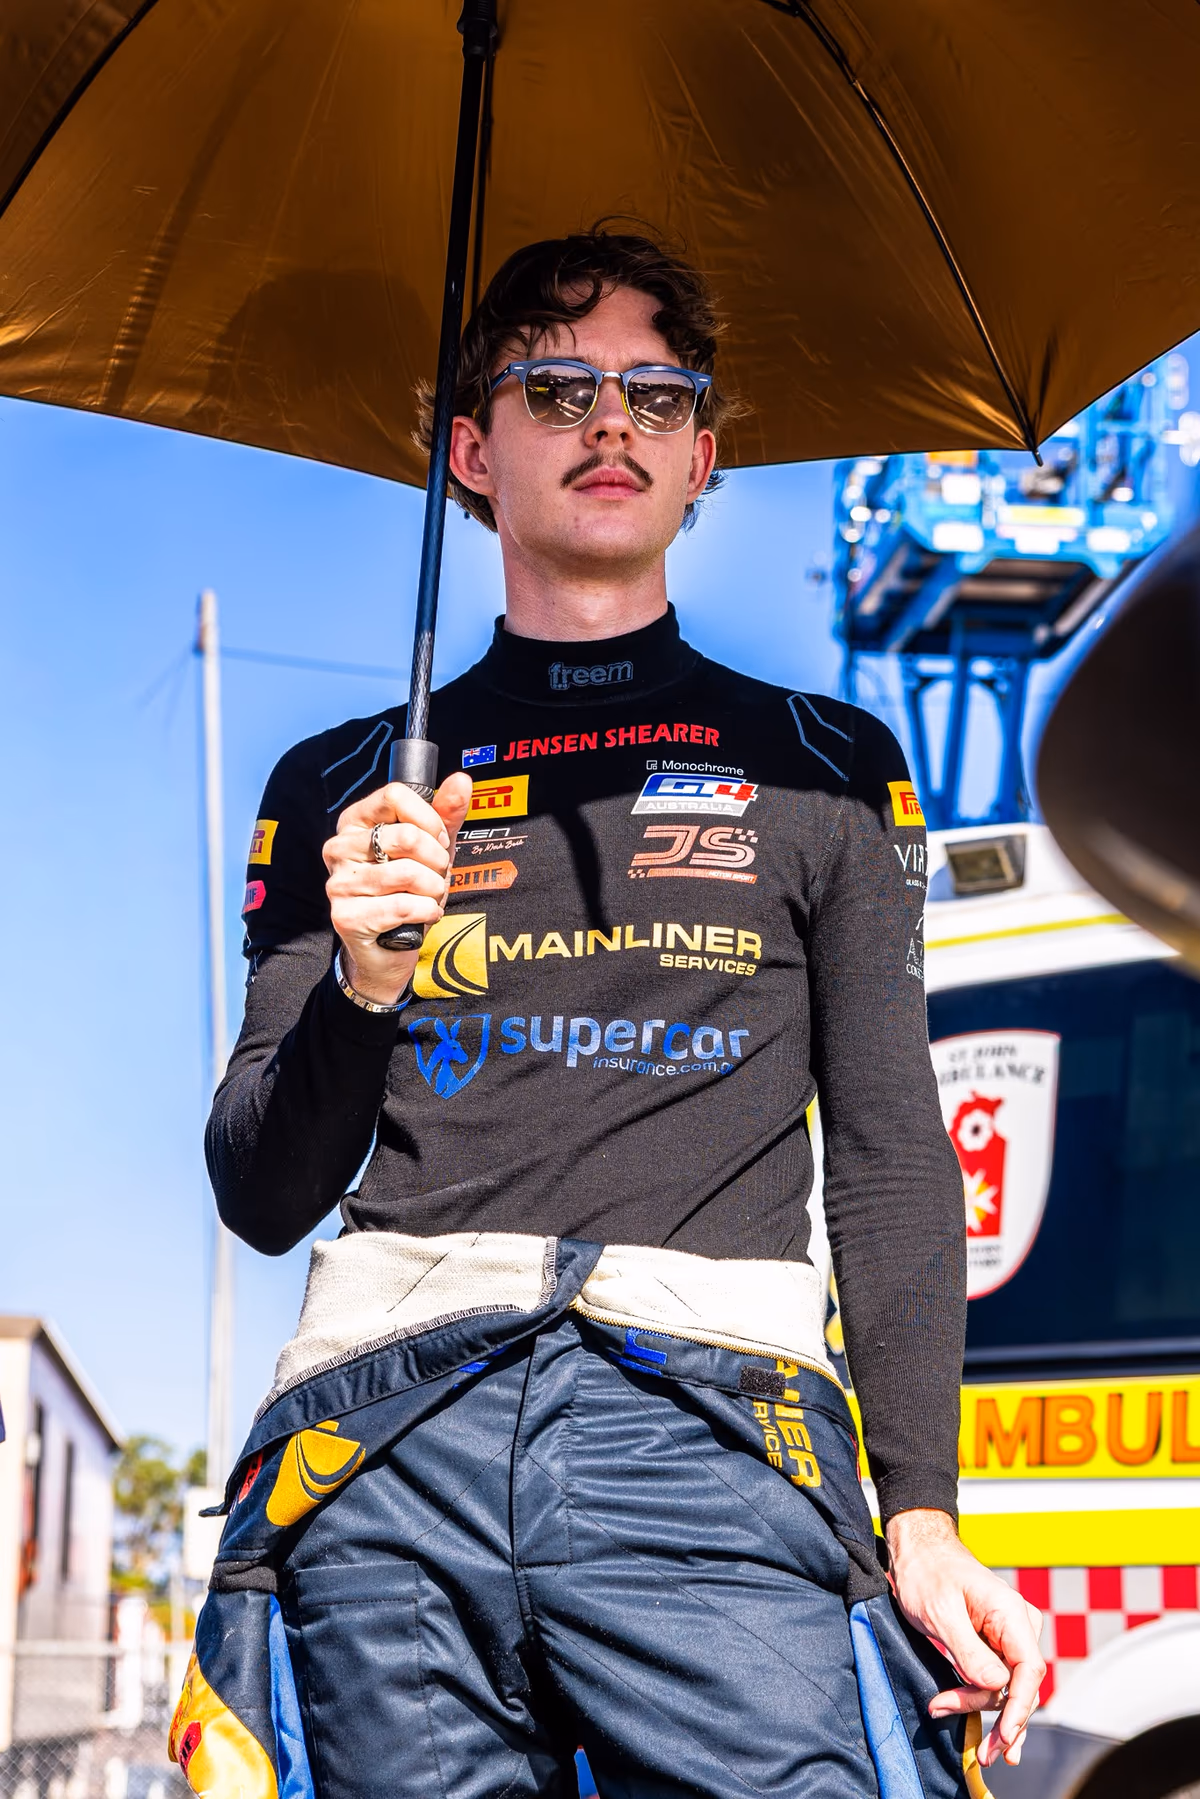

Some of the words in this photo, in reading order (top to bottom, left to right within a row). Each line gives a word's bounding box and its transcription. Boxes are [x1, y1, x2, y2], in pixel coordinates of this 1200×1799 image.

[550, 661, 633, 688] freem
[503, 732, 598, 760] JENSEN
[604, 723, 720, 748] SHEARER
[662, 760, 744, 775] Monochrome
[646, 801, 734, 812] AUSTRALIA
[631, 825, 756, 868] JS
[450, 867, 503, 887] RITIF
[489, 922, 763, 962] MAINLINER
[659, 954, 757, 976] SERVICES
[501, 1015, 750, 1068] supercar
[593, 1056, 735, 1077] insurance.com.a
[752, 1399, 783, 1470] RVICE
[958, 1389, 1200, 1470] MBUL
